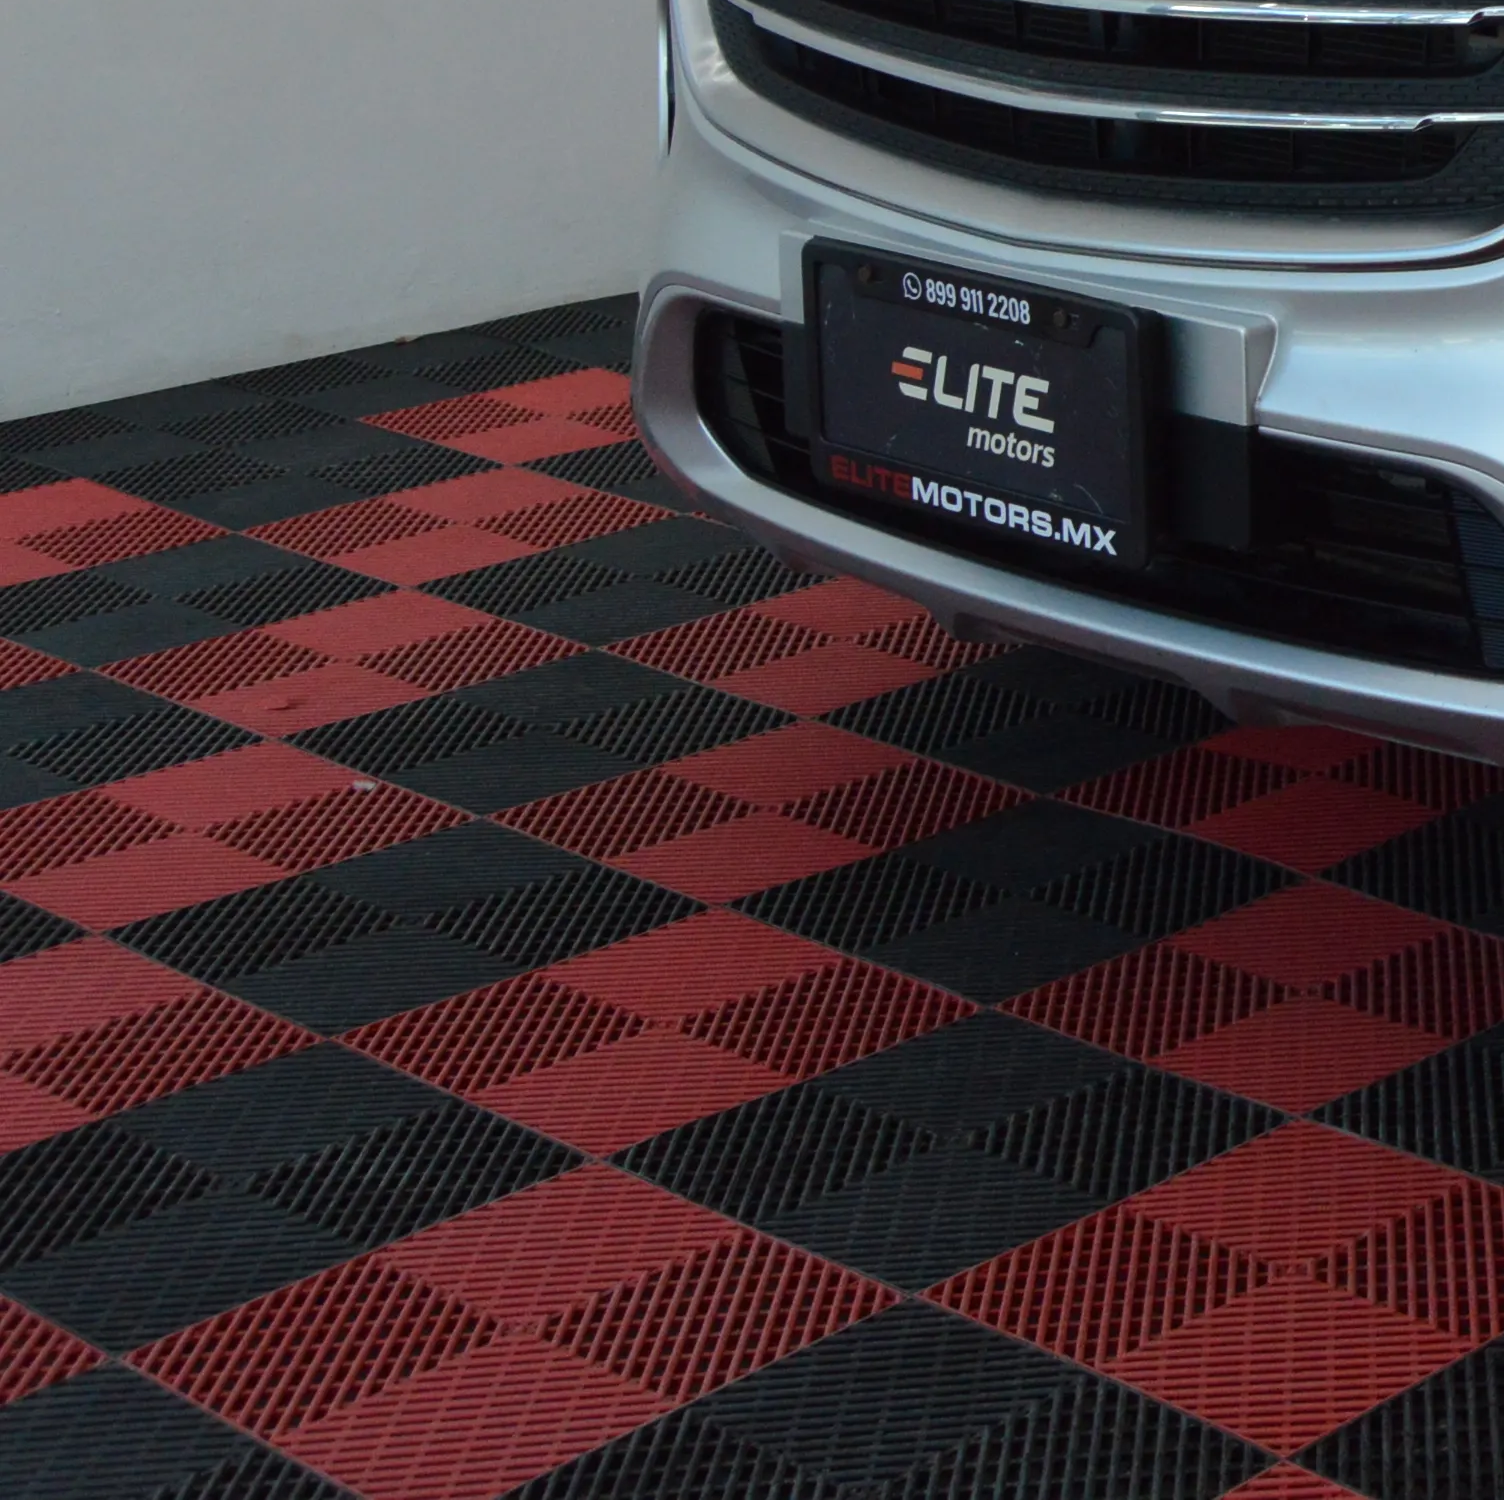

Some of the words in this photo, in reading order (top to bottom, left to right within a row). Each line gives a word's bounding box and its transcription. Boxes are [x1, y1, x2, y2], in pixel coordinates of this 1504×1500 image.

[925, 276, 957, 310] 899
[959, 284, 984, 315] 911
[987, 293, 1032, 326] 2208
[891, 346, 1055, 434] ELITE
[966, 426, 1056, 468] motors
[829, 454, 1118, 557] ELITEMOTORS.MX
